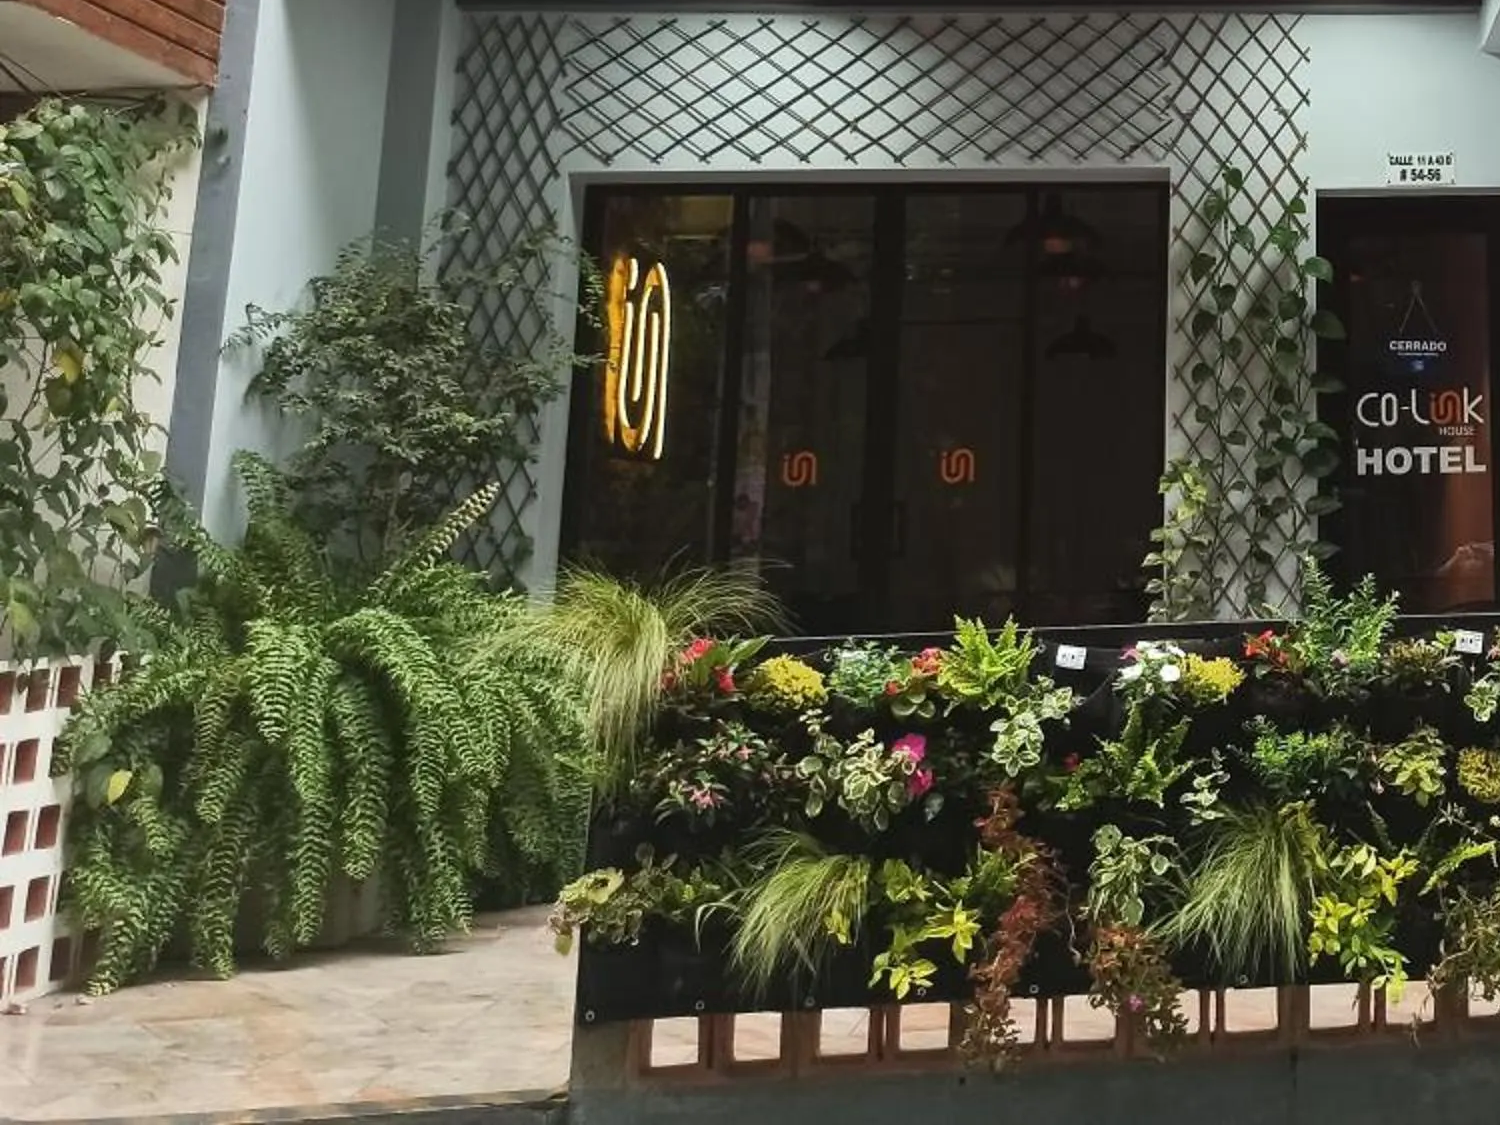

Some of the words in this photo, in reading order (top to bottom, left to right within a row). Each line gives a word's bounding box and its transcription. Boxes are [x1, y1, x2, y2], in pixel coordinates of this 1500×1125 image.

[1389, 155, 1413, 166] CALLE
[1389, 340, 1447, 352] CERRADO
[1439, 426, 1475, 436] HOUSE
[1357, 446, 1487, 475] HOTEL
